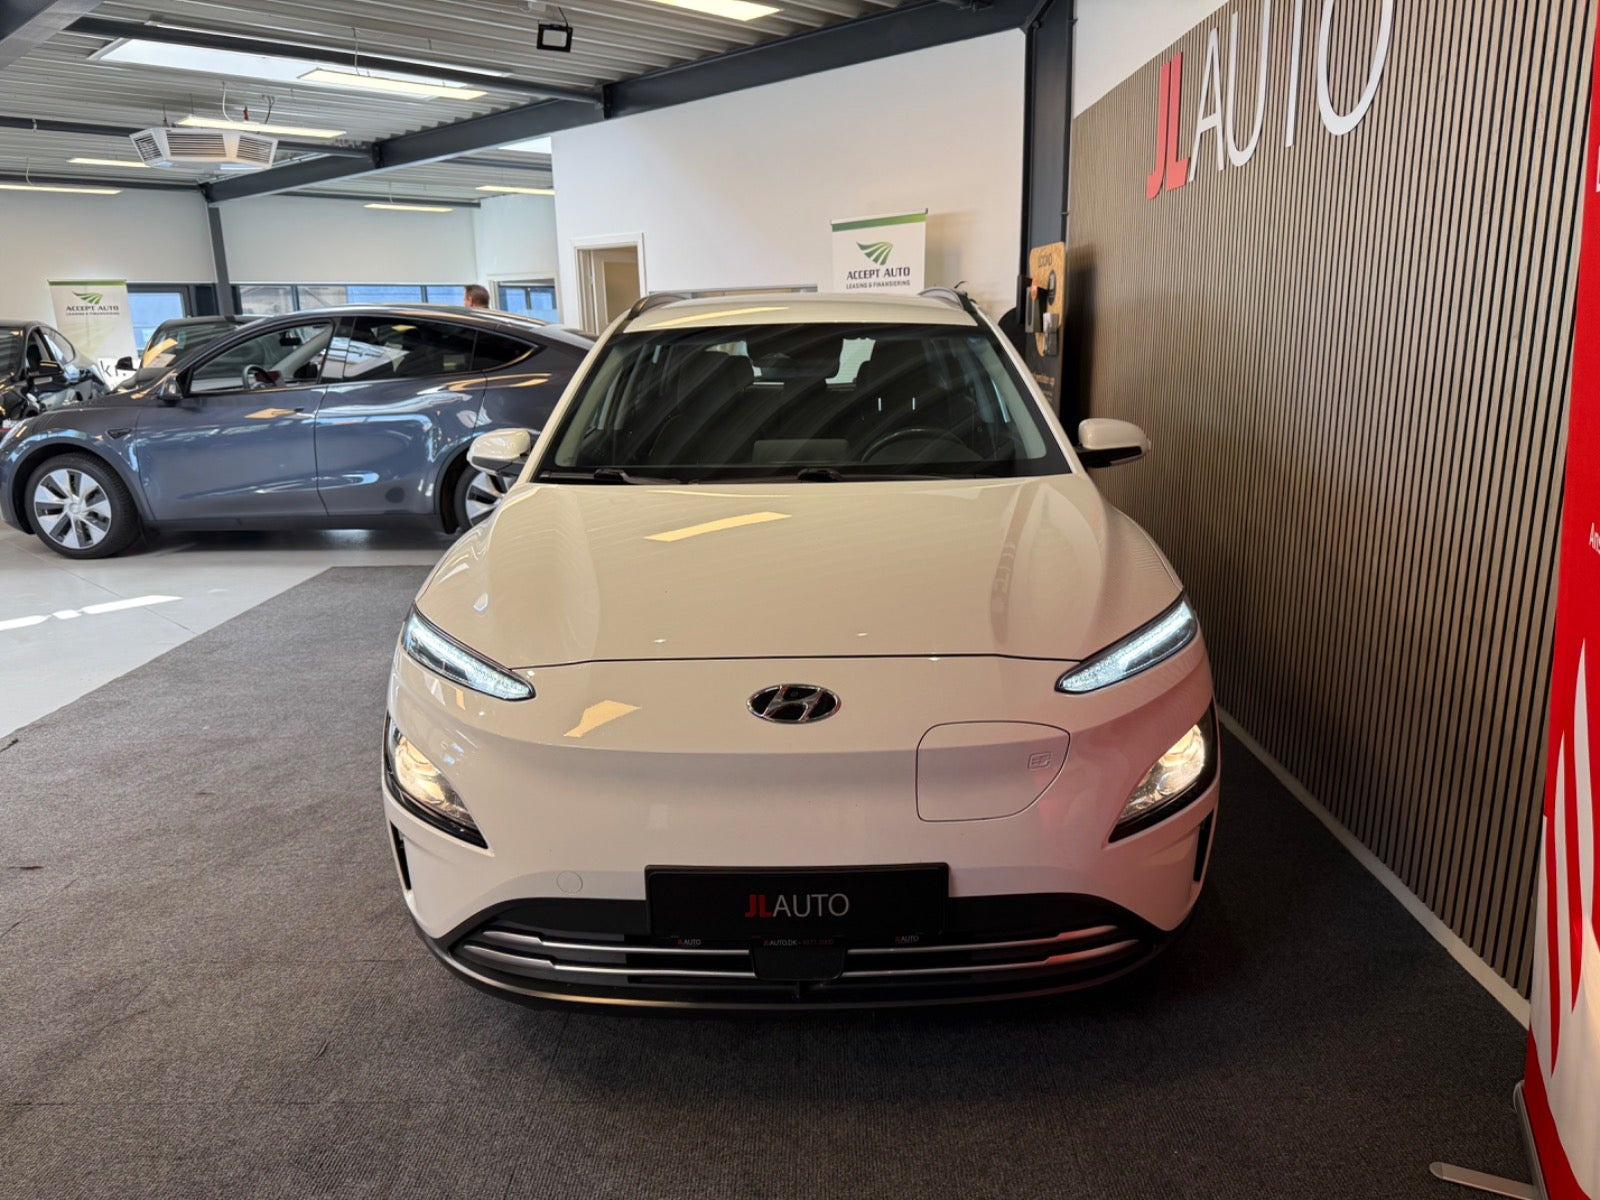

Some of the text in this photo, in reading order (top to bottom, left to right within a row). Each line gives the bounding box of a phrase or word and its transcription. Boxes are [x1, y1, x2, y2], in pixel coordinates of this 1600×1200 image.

[846, 266, 911, 280] ACCEPT AUTO
[846, 281, 867, 290] LEASING
[744, 893, 850, 918] JLAUTO
